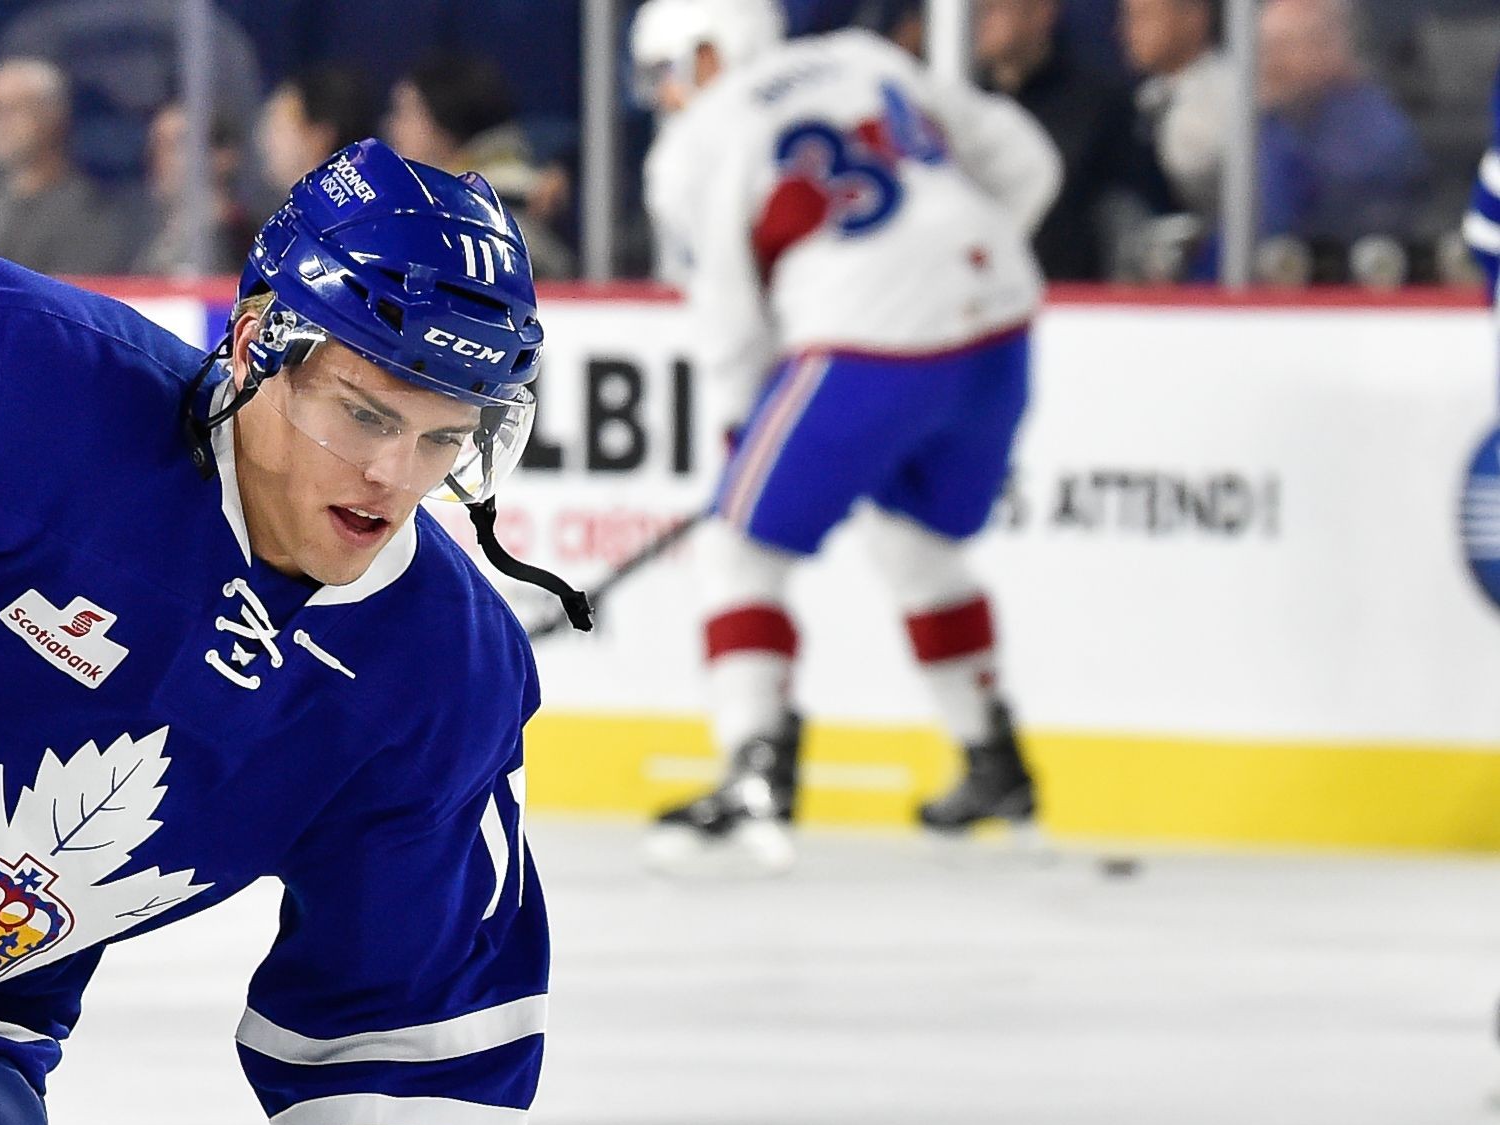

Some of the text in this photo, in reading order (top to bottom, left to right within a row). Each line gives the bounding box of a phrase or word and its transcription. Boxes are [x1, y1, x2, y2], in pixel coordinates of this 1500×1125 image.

[320, 174, 350, 207] VISION
[460, 233, 494, 284] 11
[424, 327, 506, 364] CCM
[8, 607, 103, 681] Scotiabank
